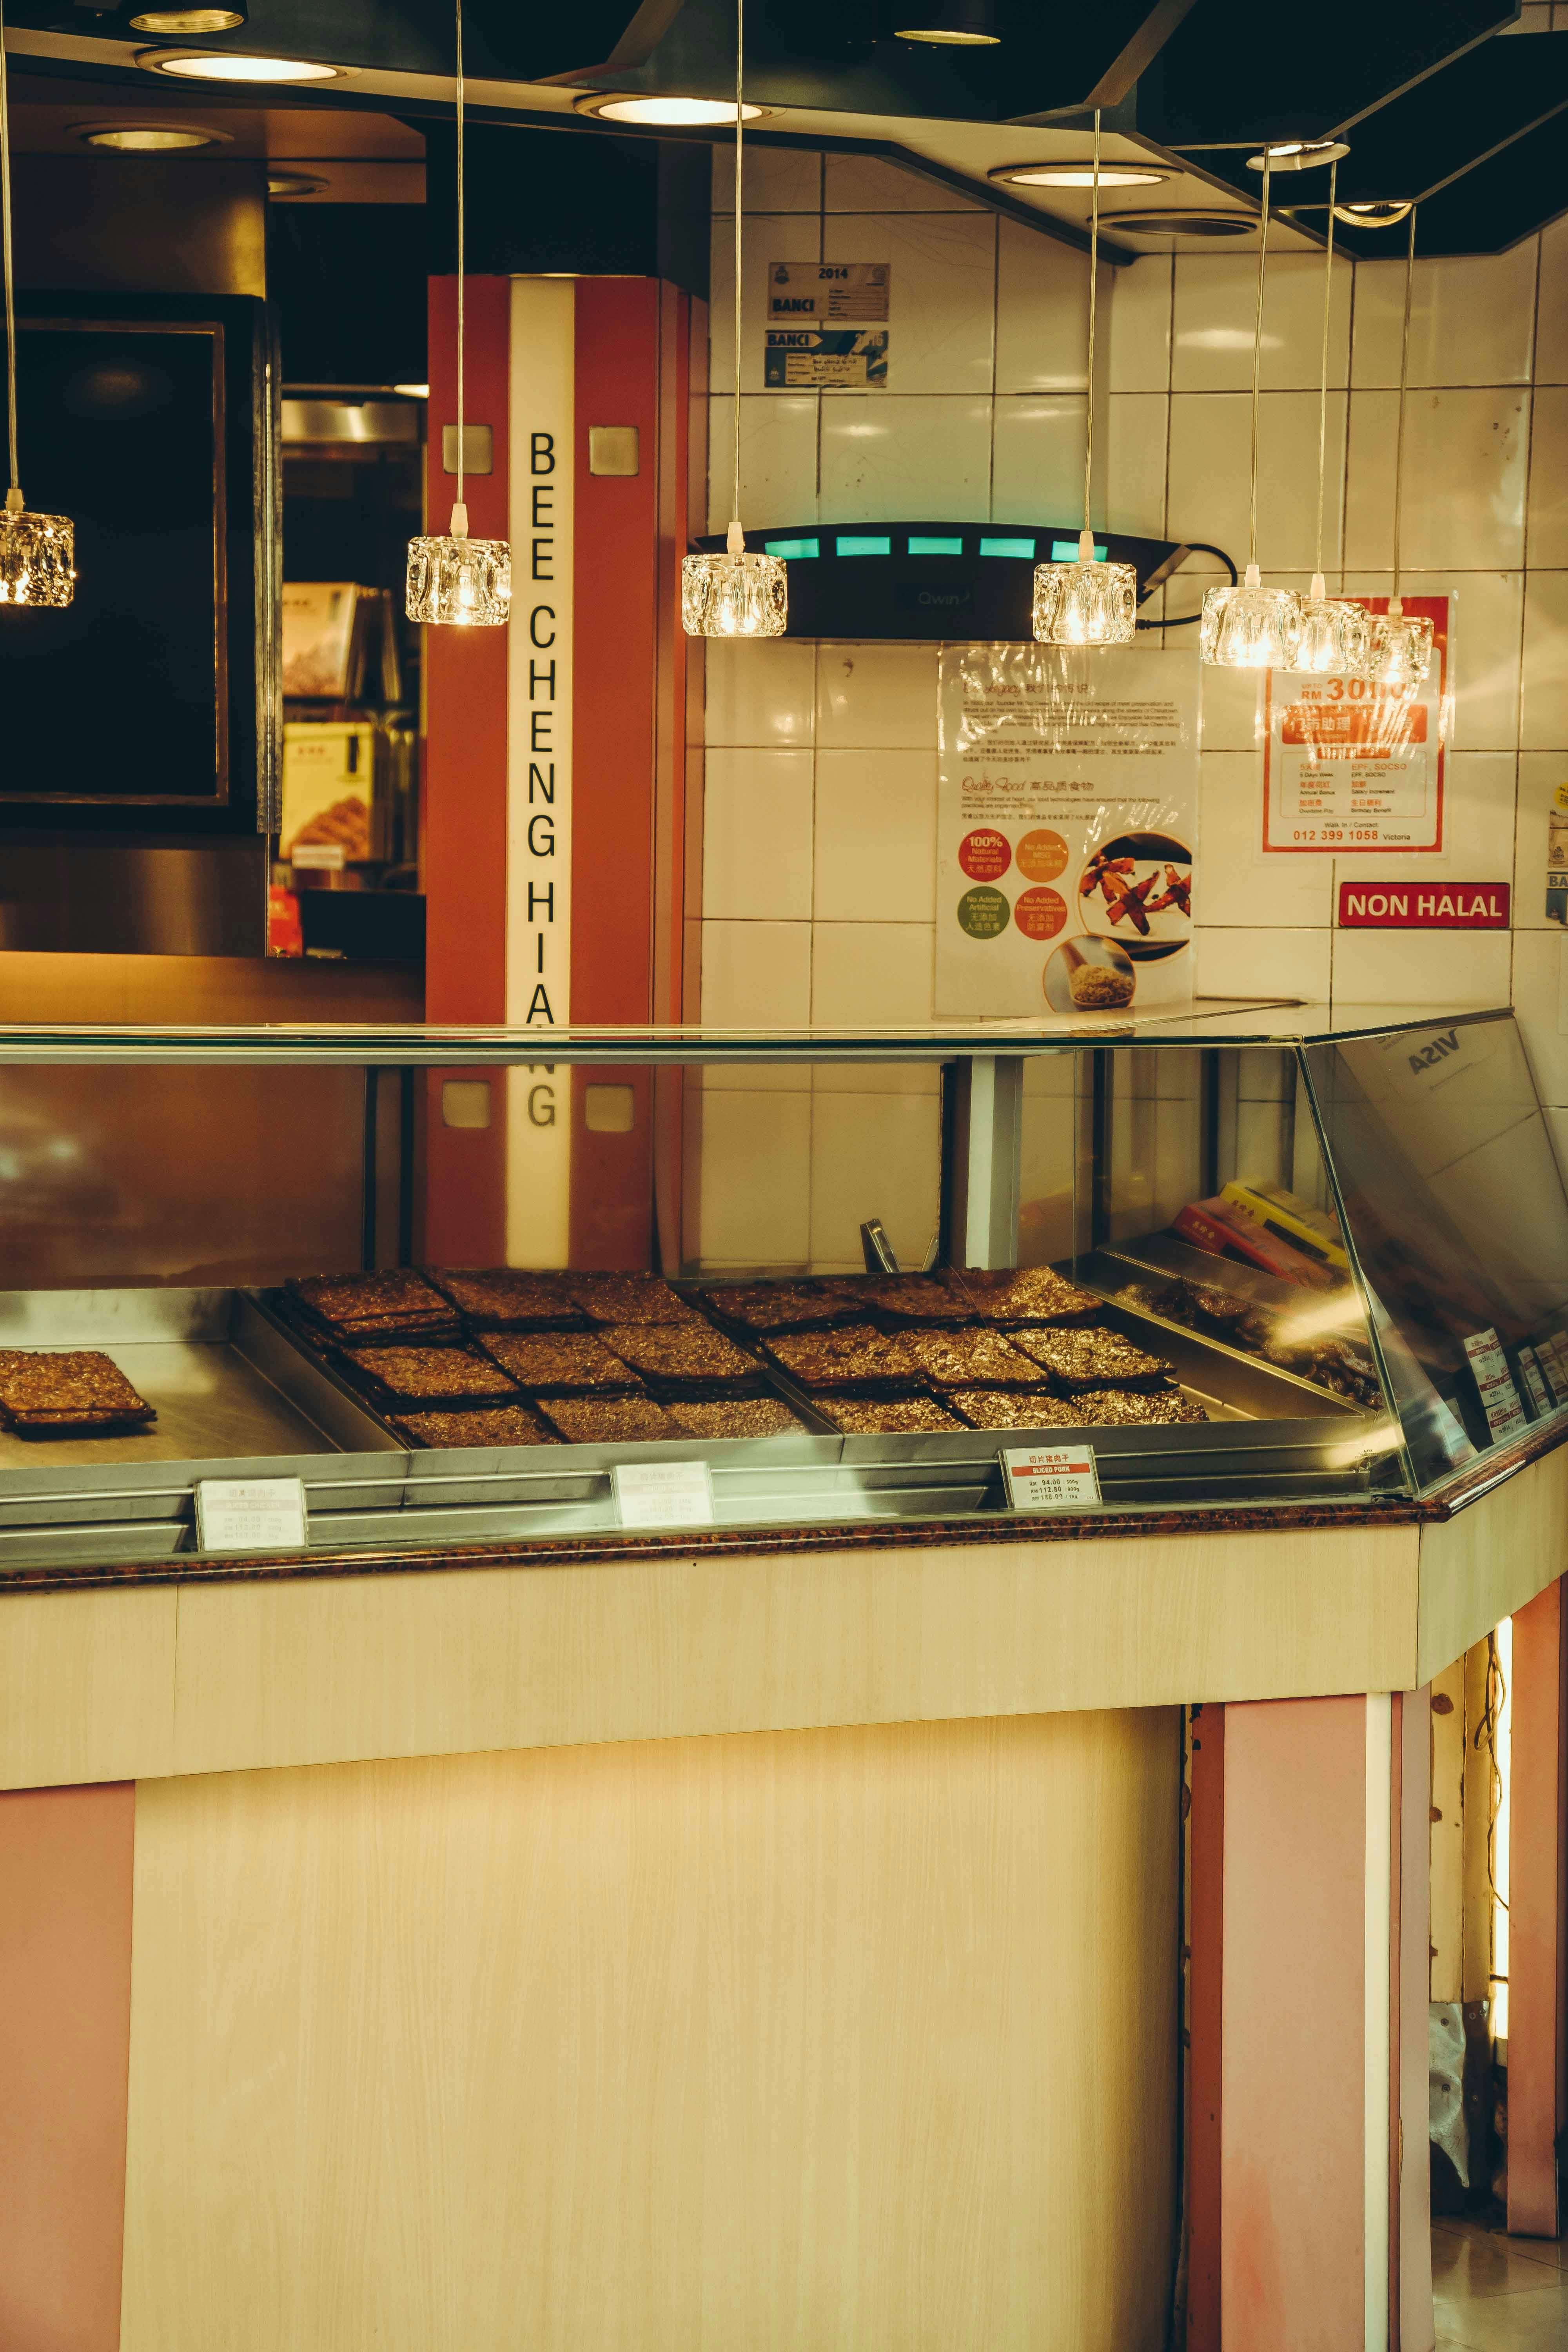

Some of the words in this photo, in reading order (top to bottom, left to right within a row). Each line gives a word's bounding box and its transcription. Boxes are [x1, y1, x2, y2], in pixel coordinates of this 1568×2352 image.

[818, 268, 848, 279] 2014
[773, 298, 815, 312] BANCI
[767, 334, 809, 346] BANCI
[530, 432, 555, 582] BEE
[1301, 691, 1322, 700] RM
[528, 605, 556, 858] CHENG
[962, 776, 994, 794] Quality
[1030, 781, 1095, 791] 高品质食物
[1294, 830, 1316, 840] 012
[1321, 830, 1343, 840] 399
[1348, 830, 1378, 840] 1058
[969, 836, 1004, 847] 100%
[967, 865, 1002, 873] 天然原料
[1016, 904, 1066, 912] Preservatives
[1347, 894, 1408, 916] NON
[1418, 895, 1502, 917] HALAL
[526, 882, 555, 1127] HIAG
[1029, 1454, 1069, 1463] 切片猪肉干
